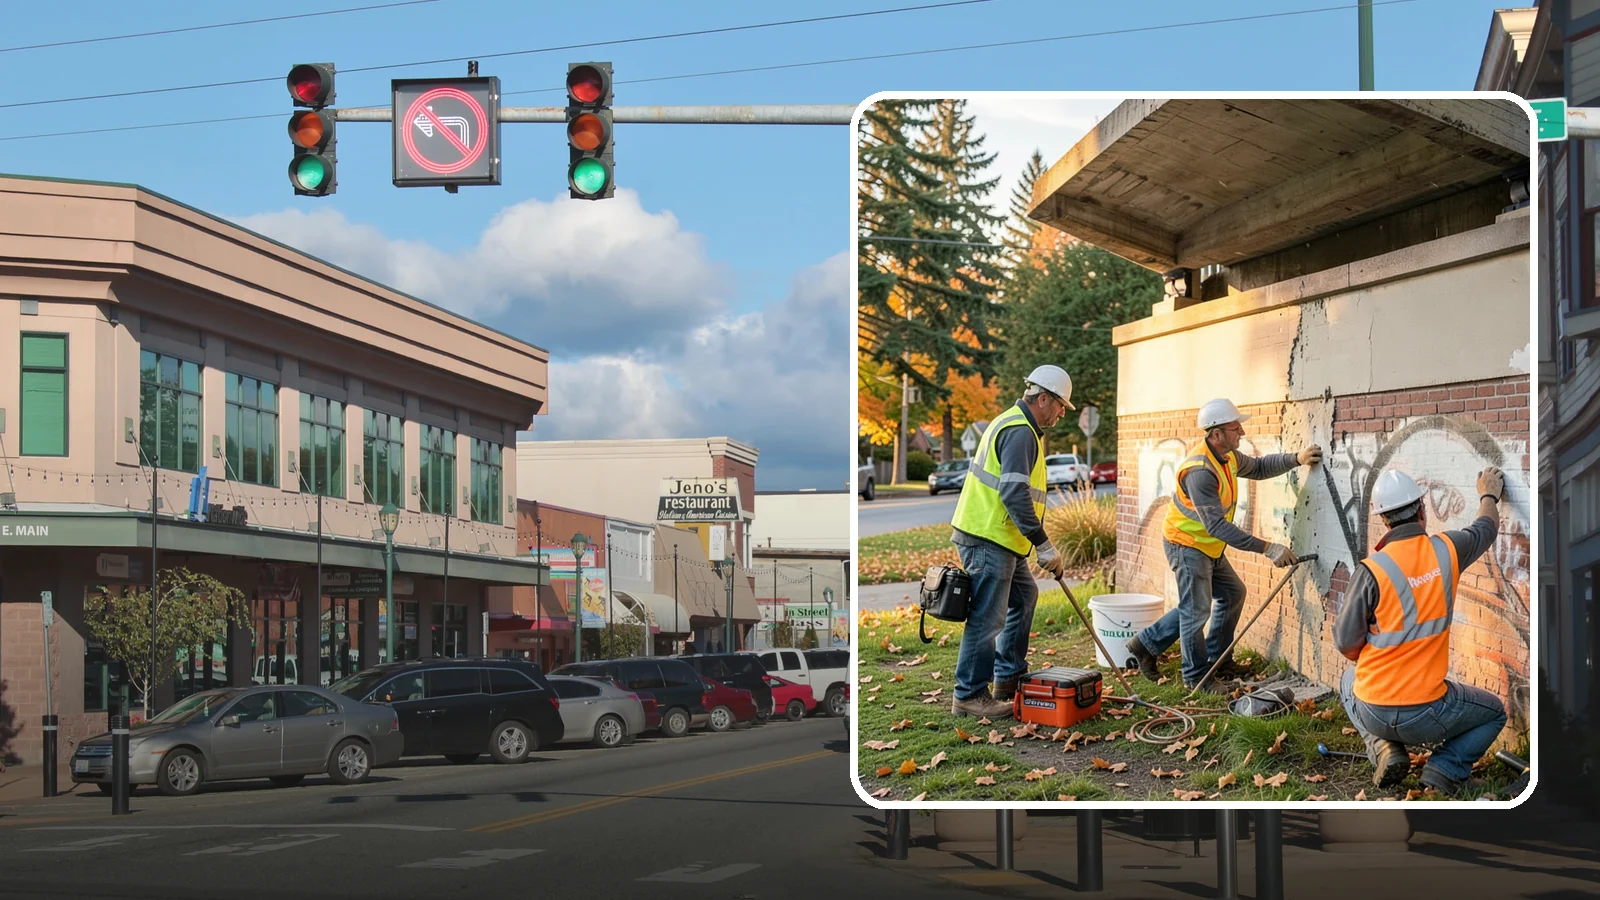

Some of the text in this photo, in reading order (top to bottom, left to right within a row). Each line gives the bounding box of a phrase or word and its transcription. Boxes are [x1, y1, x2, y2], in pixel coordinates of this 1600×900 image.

[670, 480, 727, 494] Jeno's
[665, 496, 731, 509] restaurant
[658, 510, 682, 520] Italian
[686, 509, 715, 519] American
[715, 509, 738, 519] Cuisine
[2, 525, 49, 536] E. MAIN
[797, 608, 828, 617] Street
[790, 619, 824, 627] lass
